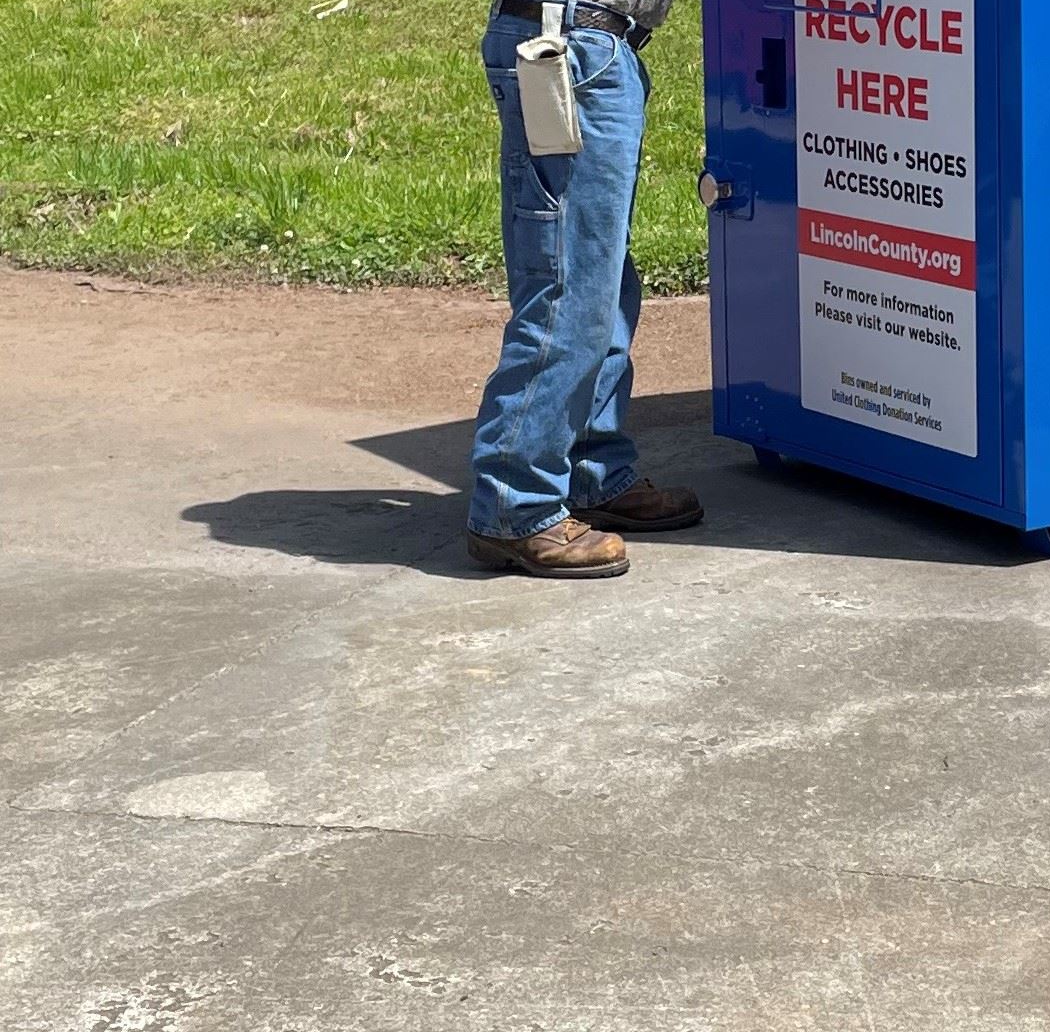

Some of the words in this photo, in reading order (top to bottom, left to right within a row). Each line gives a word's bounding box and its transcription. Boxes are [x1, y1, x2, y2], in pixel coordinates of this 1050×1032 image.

[836, 68, 928, 121] HERE
[803, 131, 888, 165] CLOTHING
[905, 148, 966, 178] SHOES
[823, 168, 944, 209] ACCESSORIES
[810, 221, 961, 276] LincolnCounty.org
[823, 280, 843, 298] For
[846, 287, 877, 306] more
[880, 292, 954, 324] information
[815, 301, 853, 325] Please
[856, 312, 881, 332] visit
[884, 320, 905, 337] our
[908, 324, 961, 351] website.
[831, 388, 853, 406] United
[854, 396, 881, 416] Clothing
[882, 403, 913, 423] Donation
[914, 411, 942, 432] Services
[841, 371, 855, 387] Bins
[856, 376, 878, 393] owned
[879, 382, 892, 397] and
[893, 385, 921, 405] serviced
[922, 392, 931, 409] by
